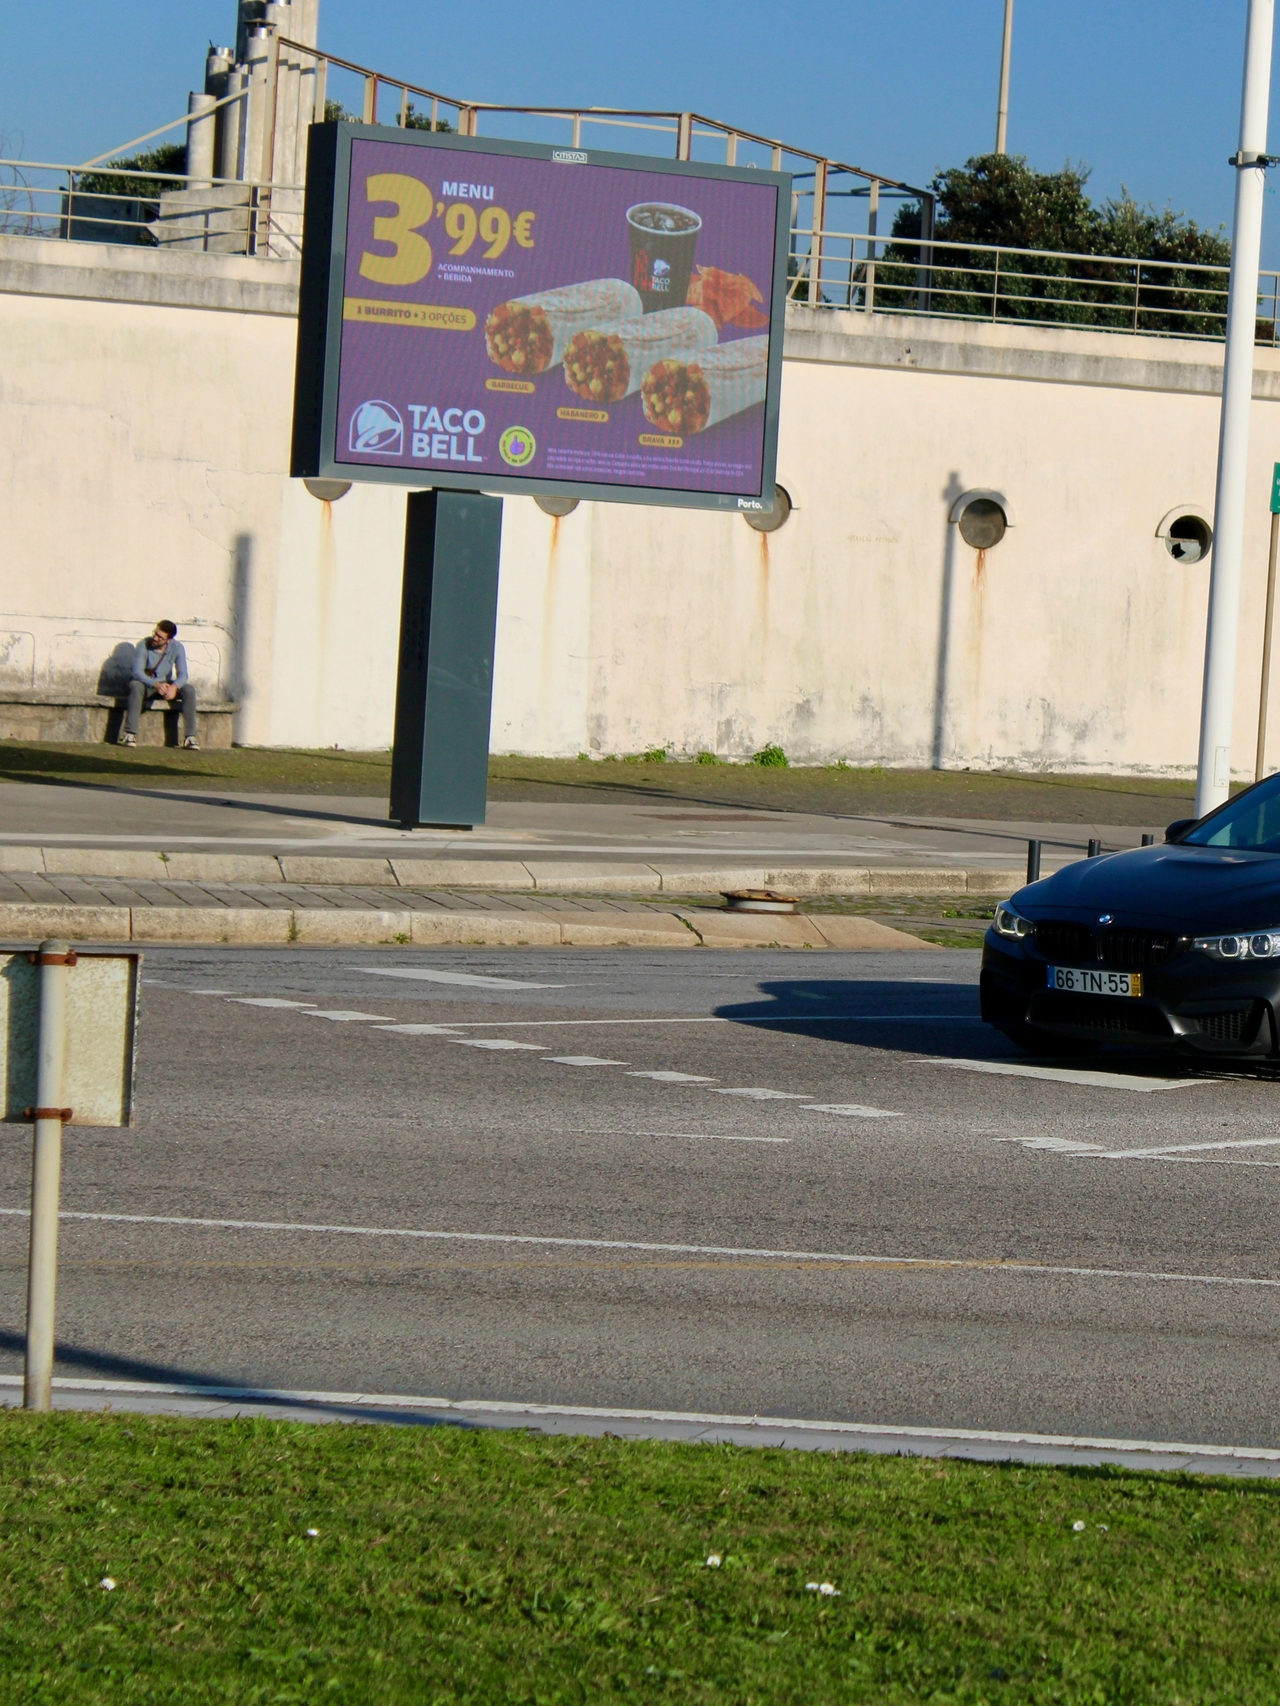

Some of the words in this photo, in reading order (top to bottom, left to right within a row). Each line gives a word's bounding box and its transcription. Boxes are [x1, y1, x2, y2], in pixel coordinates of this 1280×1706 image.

[554, 151, 586, 161] CITISTAR
[442, 181, 494, 200] MENU
[438, 263, 514, 278] ACOMPANHAMENTO
[444, 273, 472, 283] BEBIDA
[357, 305, 362, 314] 1
[365, 305, 411, 319] BURRITO
[420, 311, 426, 320] 3
[428, 310, 467, 325] OPÇÕES
[491, 381, 529, 391] BARBECUE
[408, 404, 486, 435] TACO
[560, 409, 598, 420] HABANERO
[642, 436, 665, 445] BRAVA
[411, 432, 483, 462] BELL
[737, 498, 763, 510] Porto.
